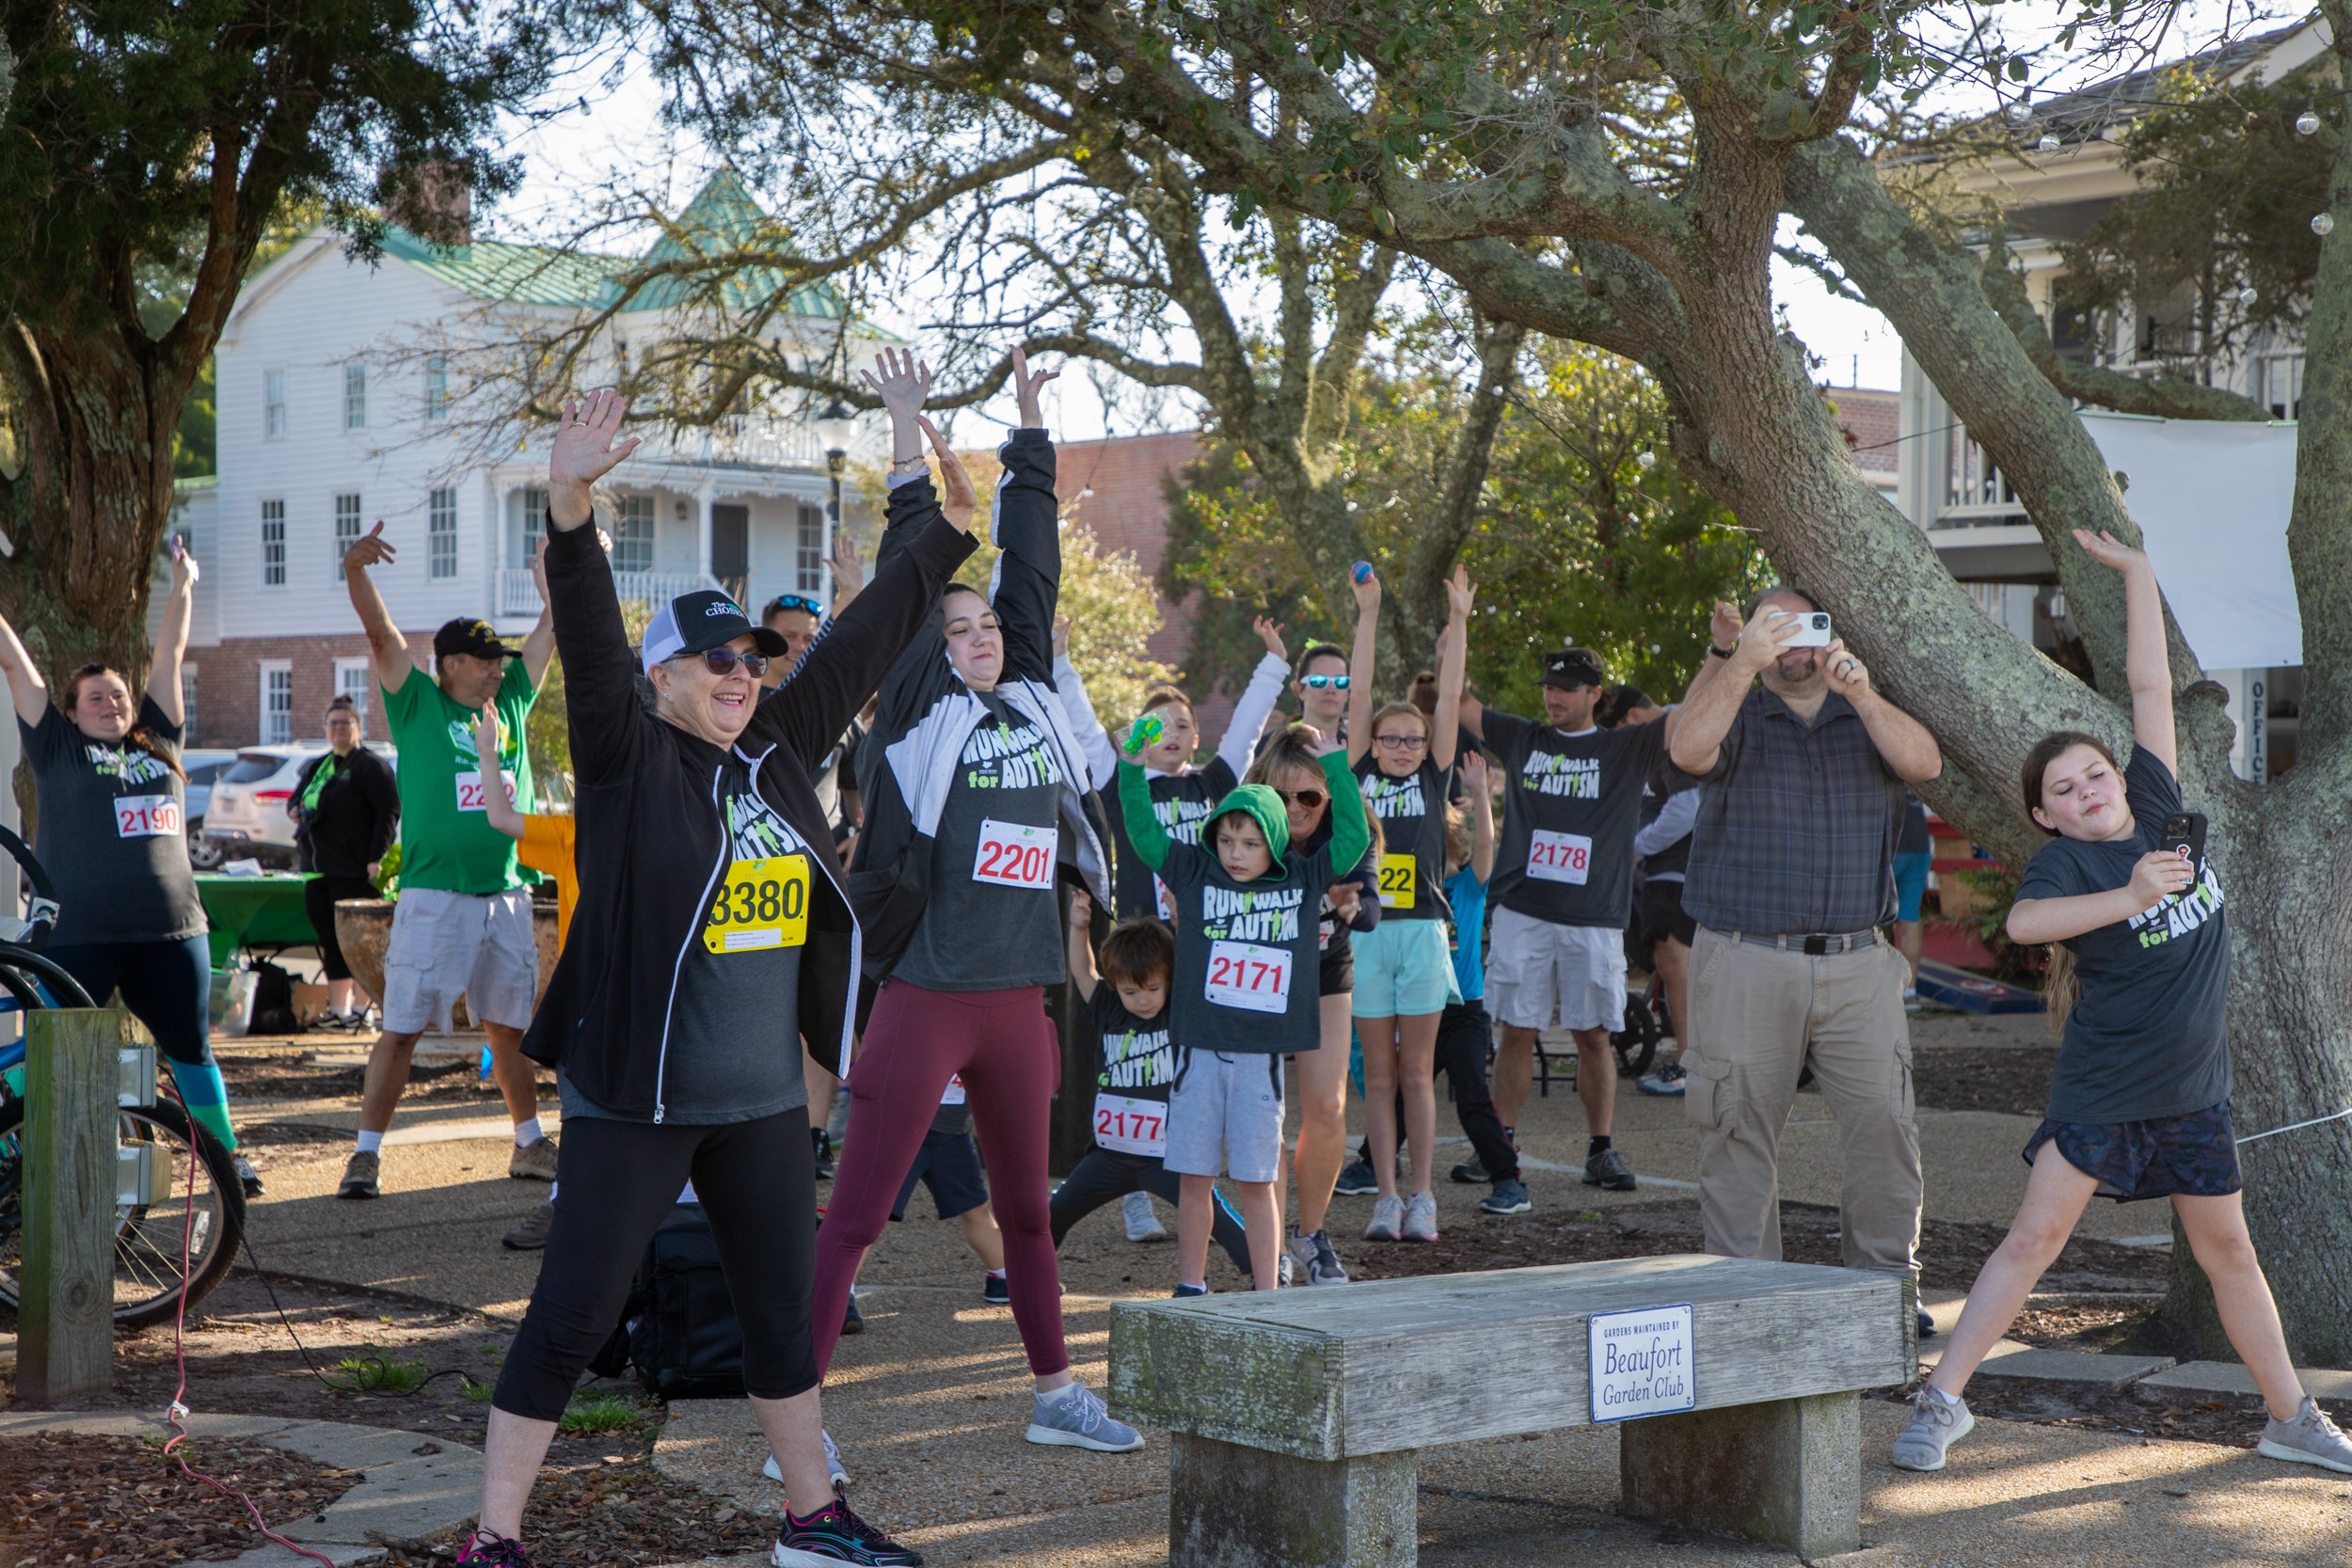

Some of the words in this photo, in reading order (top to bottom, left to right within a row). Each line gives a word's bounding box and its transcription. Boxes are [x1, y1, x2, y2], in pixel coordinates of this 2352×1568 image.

[2252, 681, 2264, 785] OFFICE
[1523, 750, 1556, 774] RUN
[1560, 758, 1599, 773] WALK
[968, 770, 999, 788] for
[1523, 777, 1539, 791] for
[1540, 770, 1599, 800] AUTISM
[459, 784, 515, 807] 222
[119, 807, 177, 833] 2190
[978, 841, 1050, 883] 2201
[1531, 842, 1587, 872] 2178
[1379, 867, 1412, 893] 22
[709, 879, 804, 927] 3380
[1204, 885, 1245, 920] RUN
[1252, 889, 1303, 911] WALK
[1204, 926, 1228, 940] for
[1230, 906, 1300, 942] AUTISM
[2138, 928, 2169, 948] for
[1210, 957, 1282, 994] 2171
[1111, 1044, 1174, 1087] AUTISM
[1097, 1109, 1162, 1141] 2177
[1604, 1326, 1631, 1338] GARDENS
[1634, 1322, 1670, 1335] MAINTAINED
[1673, 1321, 1679, 1330] BY
[1603, 1336, 1682, 1383] Beaufort
[1603, 1381, 1649, 1405] Garden
[1654, 1375, 1684, 1399] Club
